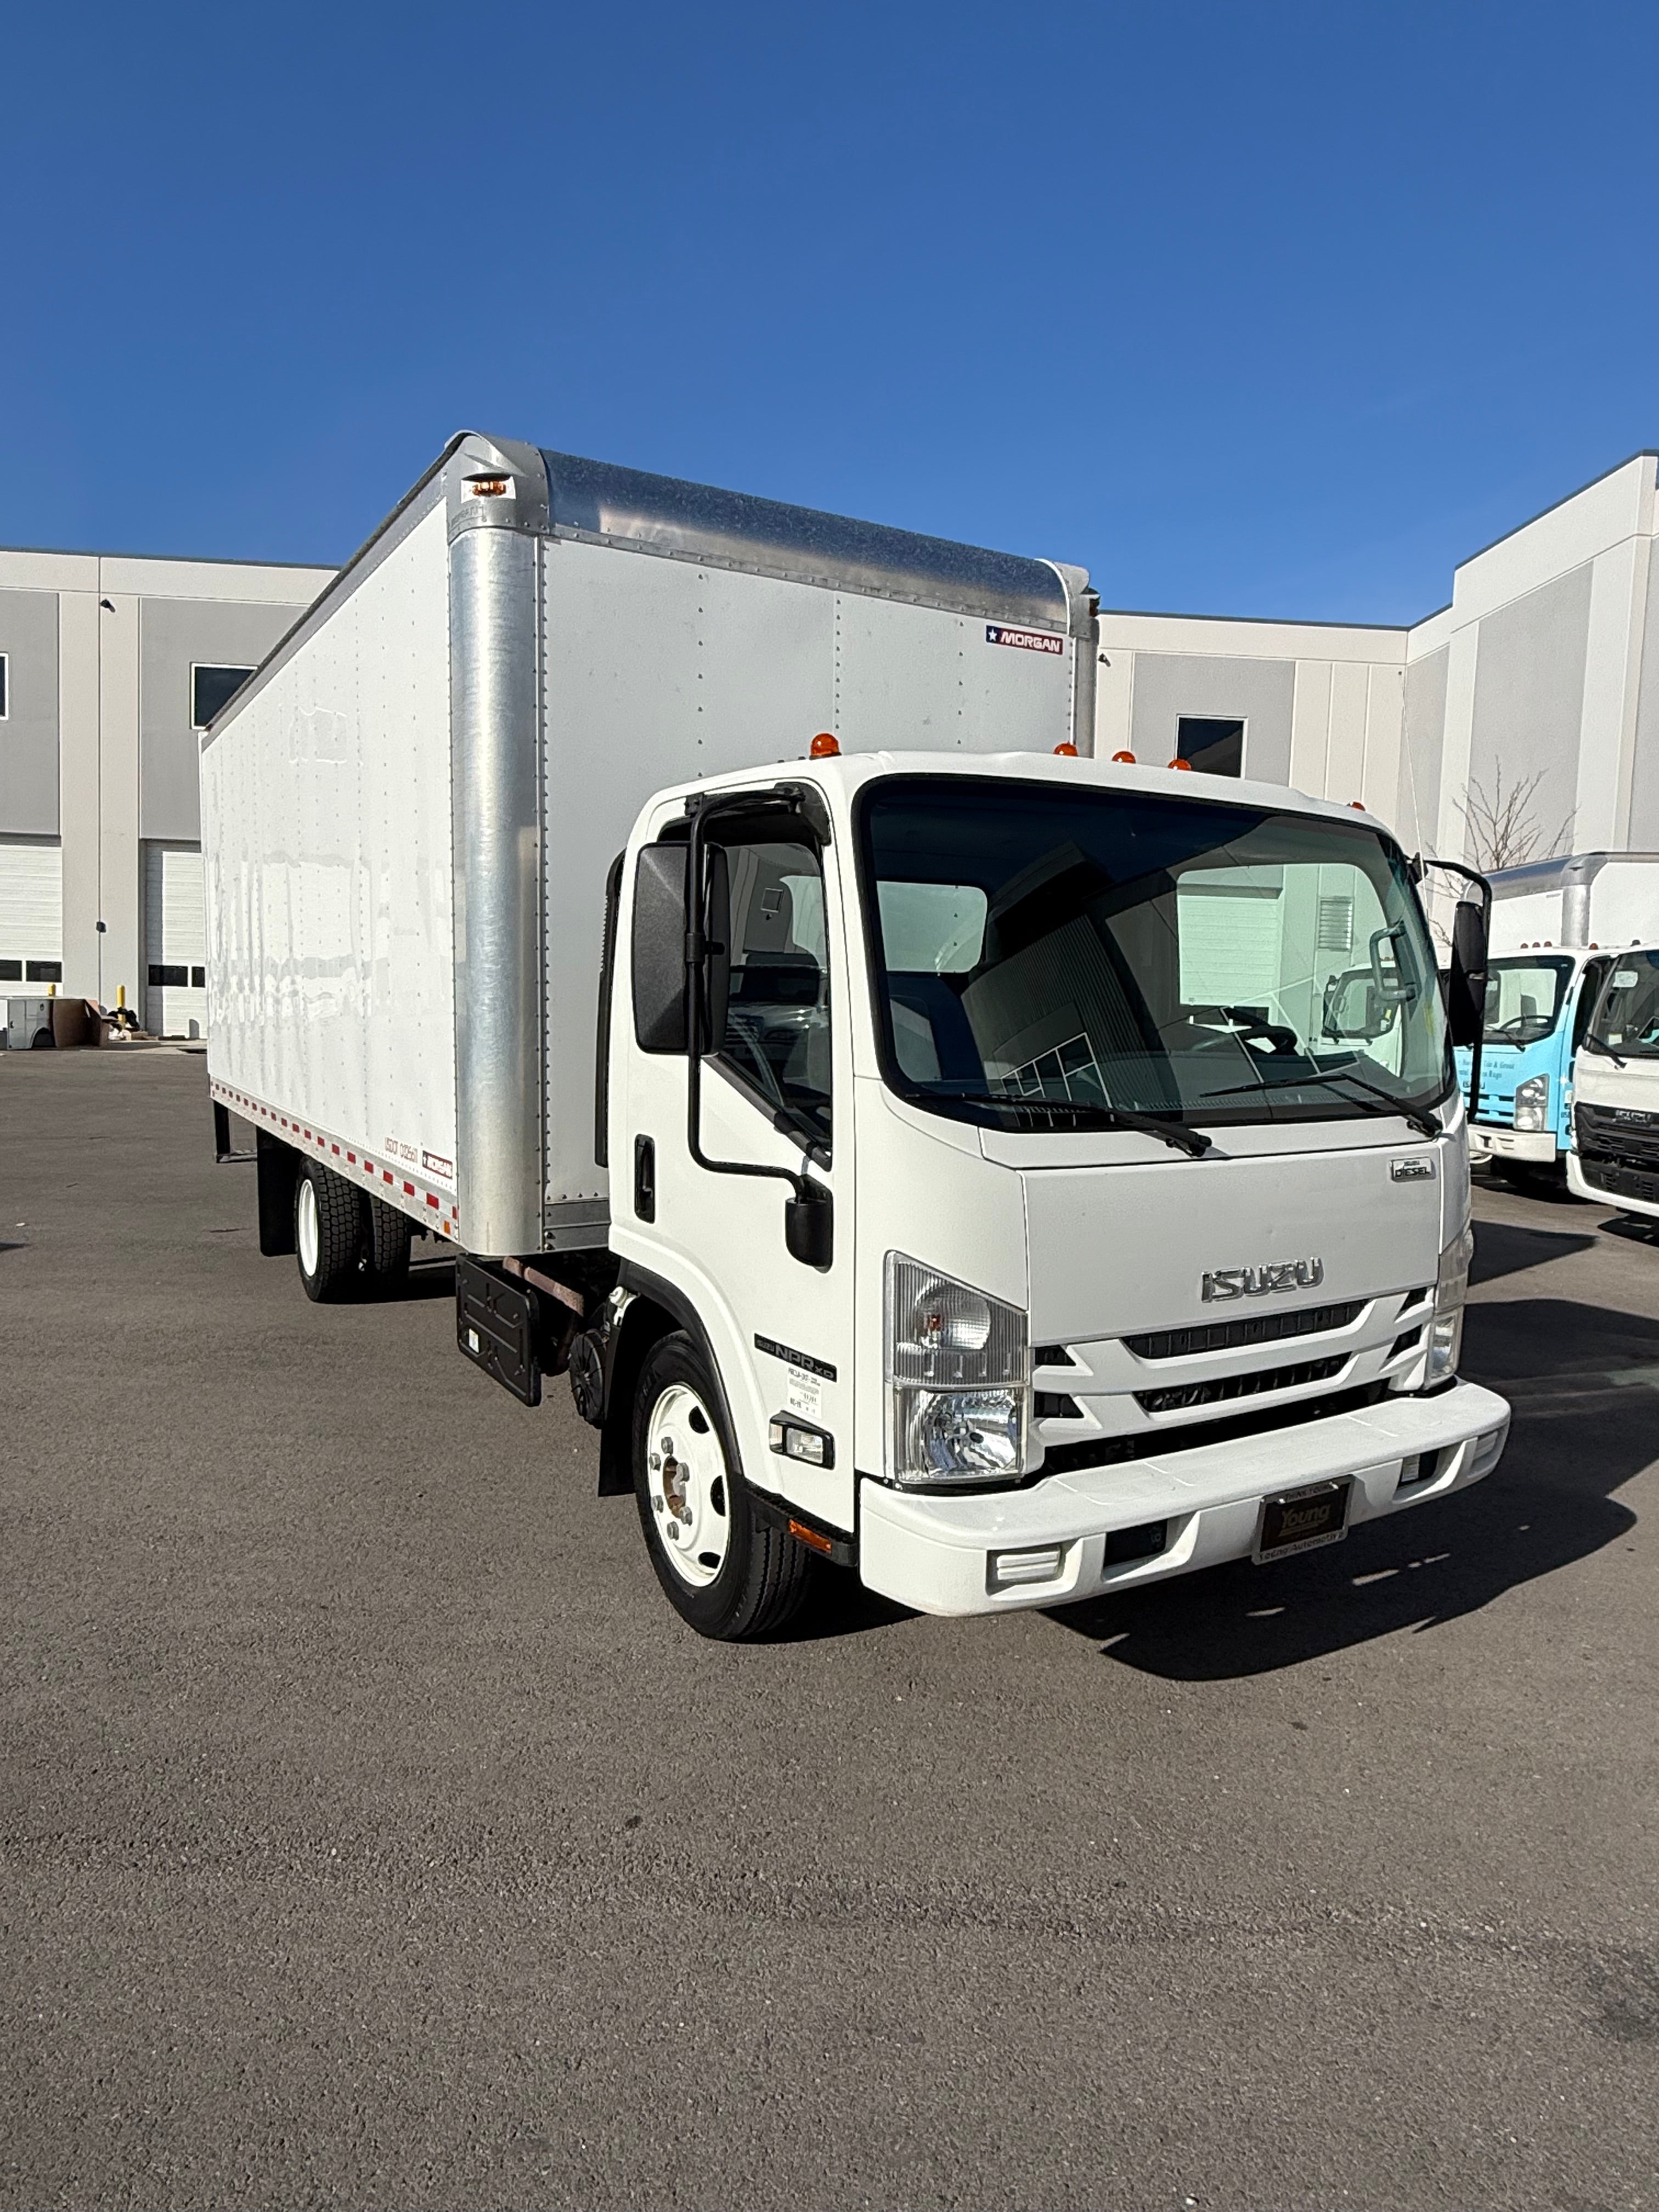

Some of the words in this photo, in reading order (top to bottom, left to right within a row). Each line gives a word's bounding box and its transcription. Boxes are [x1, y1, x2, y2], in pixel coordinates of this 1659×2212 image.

[1001, 631, 1061, 652] MORGAN
[1395, 1166, 1431, 1177] DIESEL
[1201, 1256, 1325, 1304] ISUZU
[776, 1344, 815, 1369] NPR
[1282, 1504, 1331, 1528] Young
[1292, 1531, 1344, 1550] Automotive
